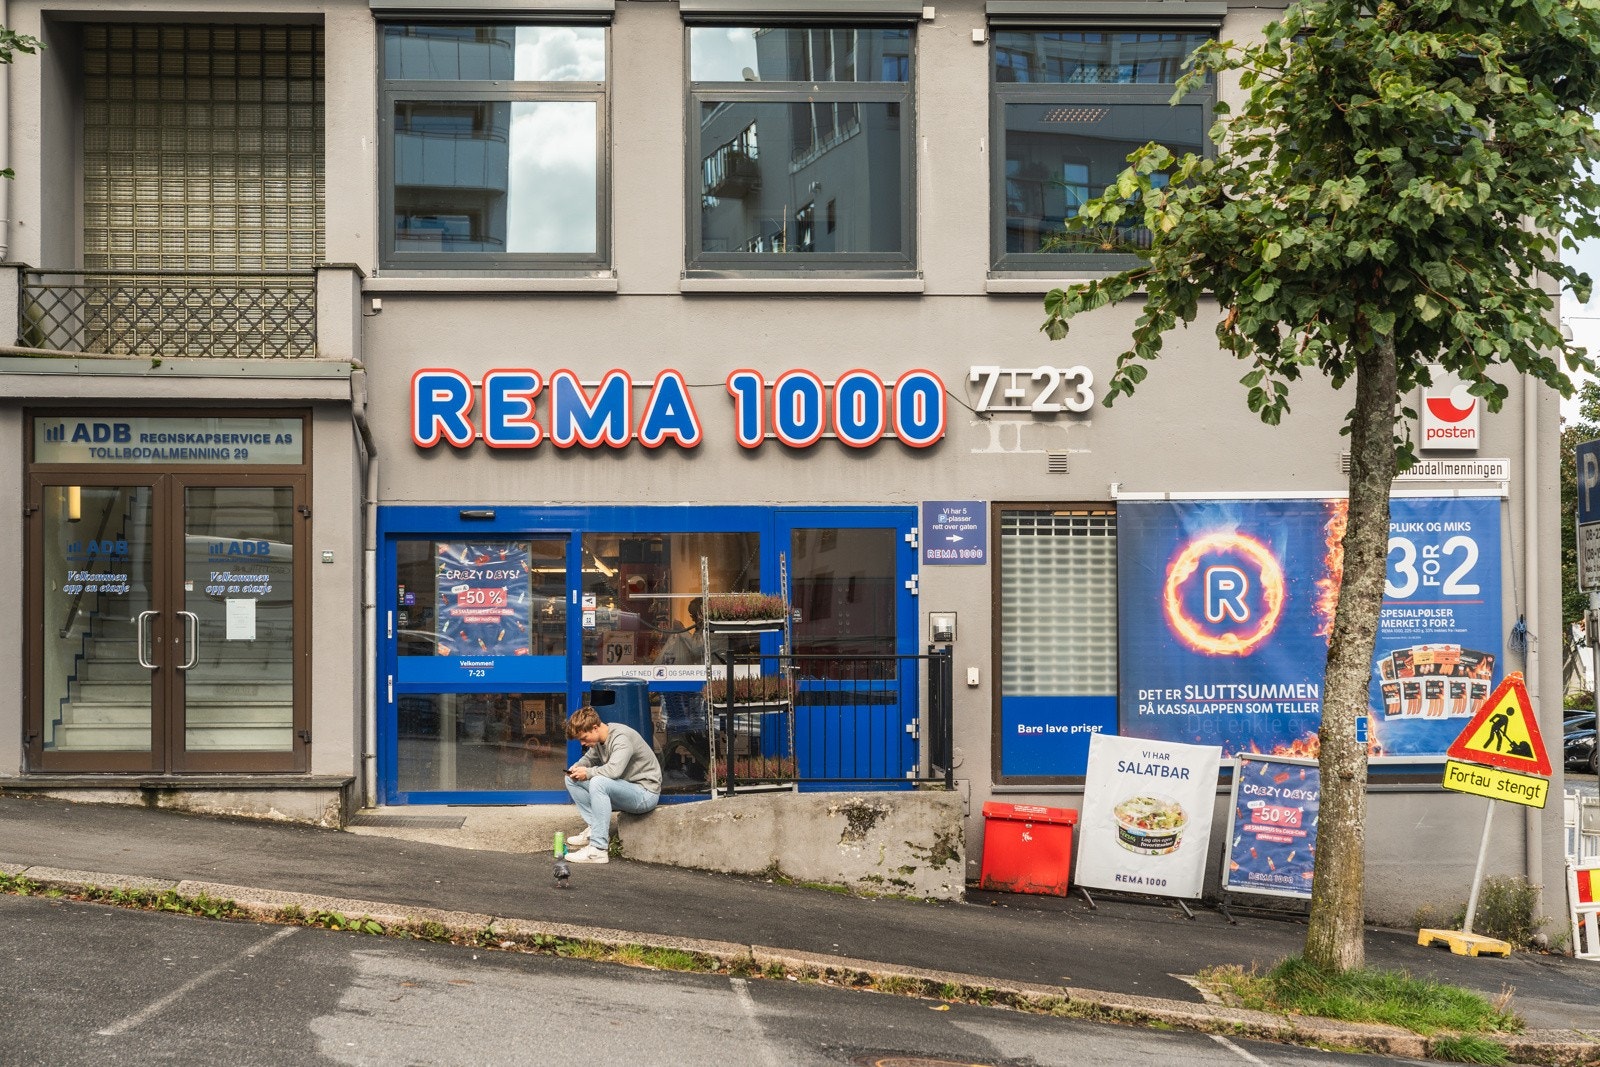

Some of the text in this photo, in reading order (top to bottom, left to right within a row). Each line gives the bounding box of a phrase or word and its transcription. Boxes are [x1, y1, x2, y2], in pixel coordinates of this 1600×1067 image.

[970, 366, 1095, 412] 7-23
[411, 368, 946, 448] REMA 1000
[71, 423, 292, 444] ADB REGNSKAPSERVICE AS
[1427, 426, 1475, 440] posten
[89, 447, 249, 460] TOLLBODALMENNING 29
[1583, 453, 1599, 512] P
[1389, 522, 1471, 532] PLUKK OG MIKS
[86, 540, 128, 554] ADB
[227, 541, 270, 556] ADB
[927, 549, 983, 558] REMA 1000
[1384, 536, 1480, 598] 3 FOR 2
[67, 571, 128, 581] Velkommen
[210, 572, 269, 582] Velkommen
[63, 582, 130, 595] opp en etasje
[205, 585, 225, 595] opp
[242, 583, 272, 595] etasje
[1204, 565, 1250, 623] R
[460, 591, 502, 604] -50 %
[1381, 609, 1453, 618] SPESIALPØLSER
[1430, 619, 1448, 627] FOR
[1450, 619, 1455, 627] 2
[607, 644, 632, 663] 59 90
[1139, 684, 1319, 700] DET ER SLUTTSUMMEN
[1139, 702, 1319, 714] PÅ KASSALAPPEN SOM TELLER
[1017, 724, 1103, 734] Bare lave priser
[1142, 751, 1170, 761] VI HAR
[1117, 760, 1190, 780] SALATBAR
[1450, 767, 1541, 800] Fortau stengt
[1254, 808, 1297, 824] -50 %
[1115, 874, 1167, 887] REMA 1000
